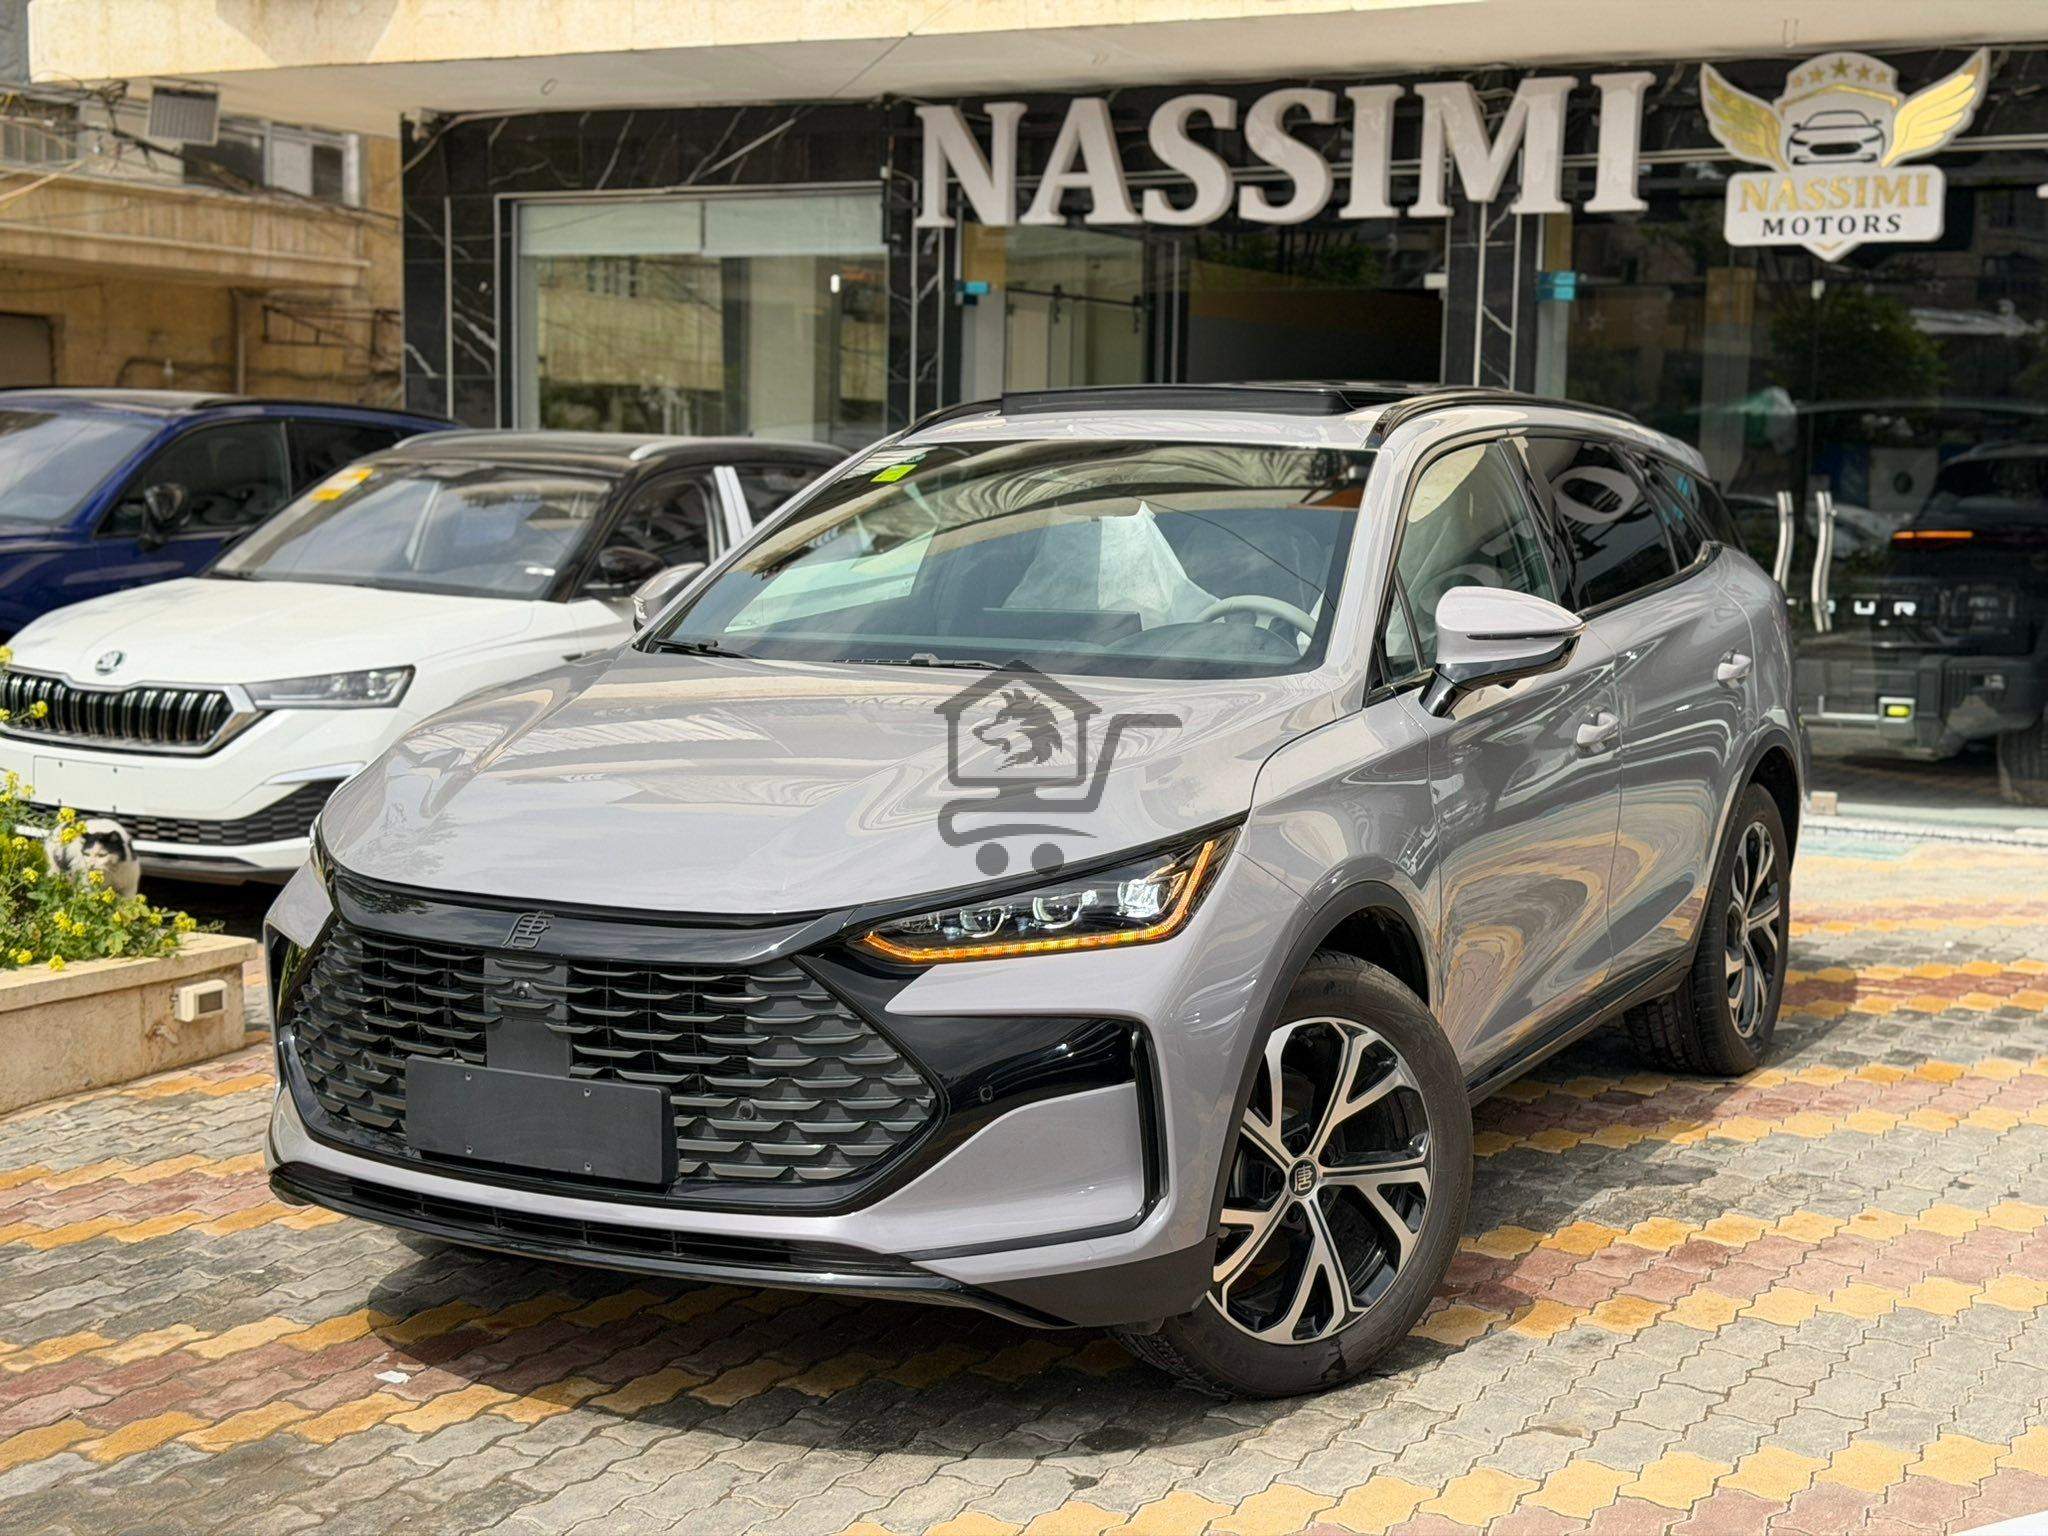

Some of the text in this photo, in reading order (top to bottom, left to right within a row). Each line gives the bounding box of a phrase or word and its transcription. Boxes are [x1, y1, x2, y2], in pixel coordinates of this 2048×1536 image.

[914, 71, 1658, 227] NASSIMI
[1740, 174, 1929, 212] NASSIMI
[1762, 214, 1902, 237] MOTORS
